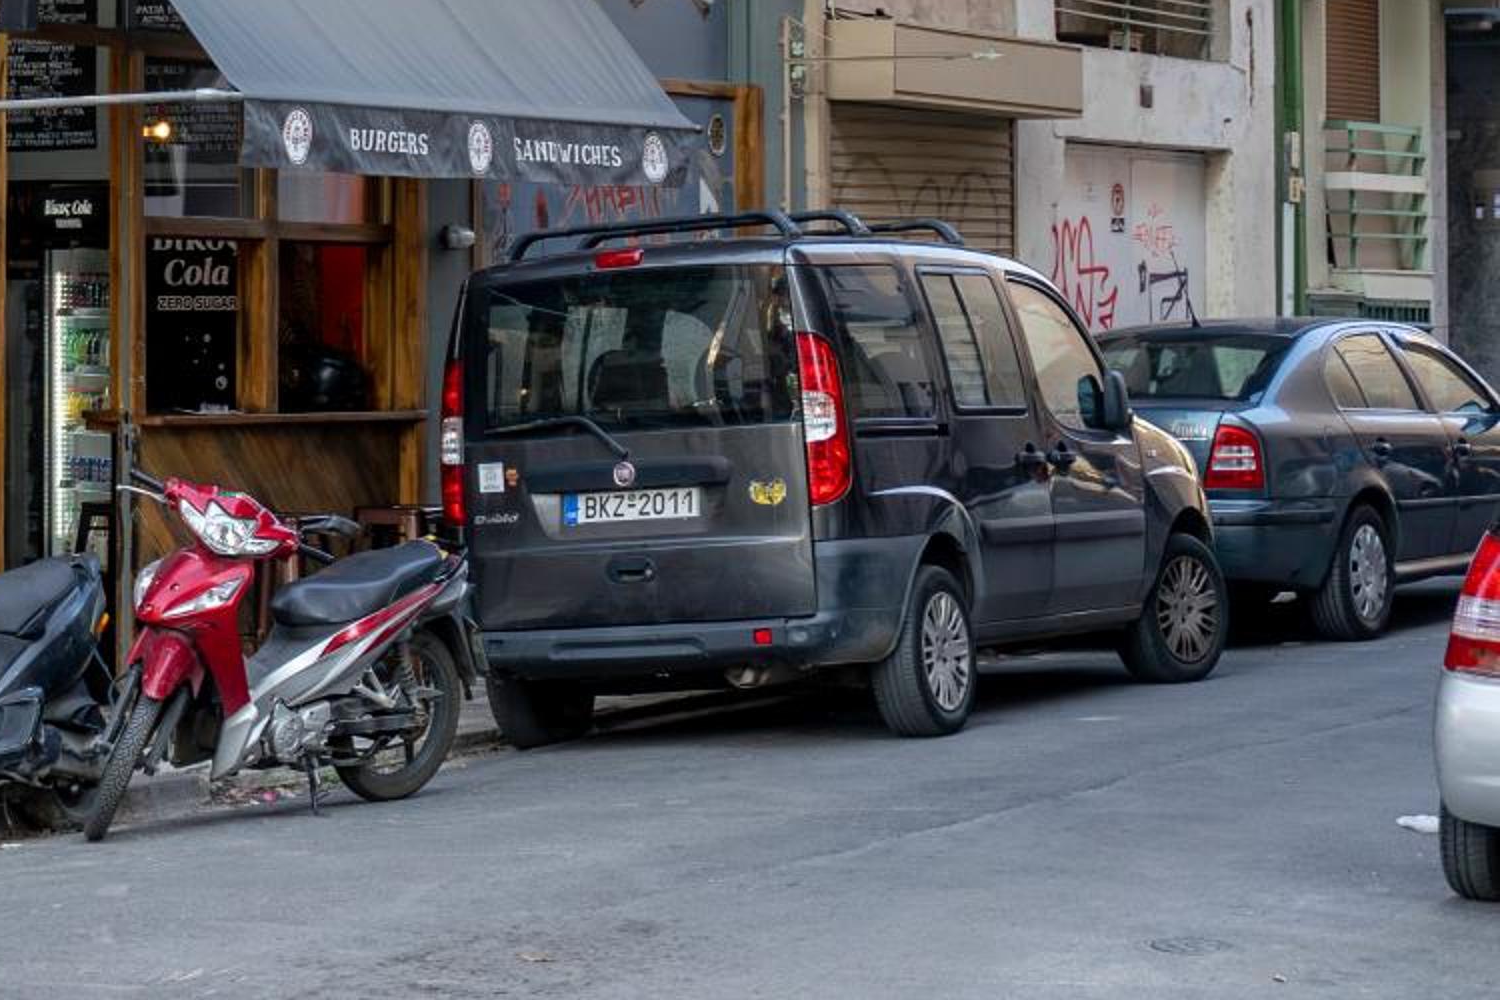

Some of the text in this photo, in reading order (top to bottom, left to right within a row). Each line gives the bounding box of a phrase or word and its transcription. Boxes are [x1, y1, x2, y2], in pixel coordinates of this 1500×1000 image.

[349, 127, 429, 156] BURGERS
[514, 136, 623, 168] SANDWICHES
[164, 256, 229, 287] Cola
[585, 489, 693, 519] BKZ-2011
